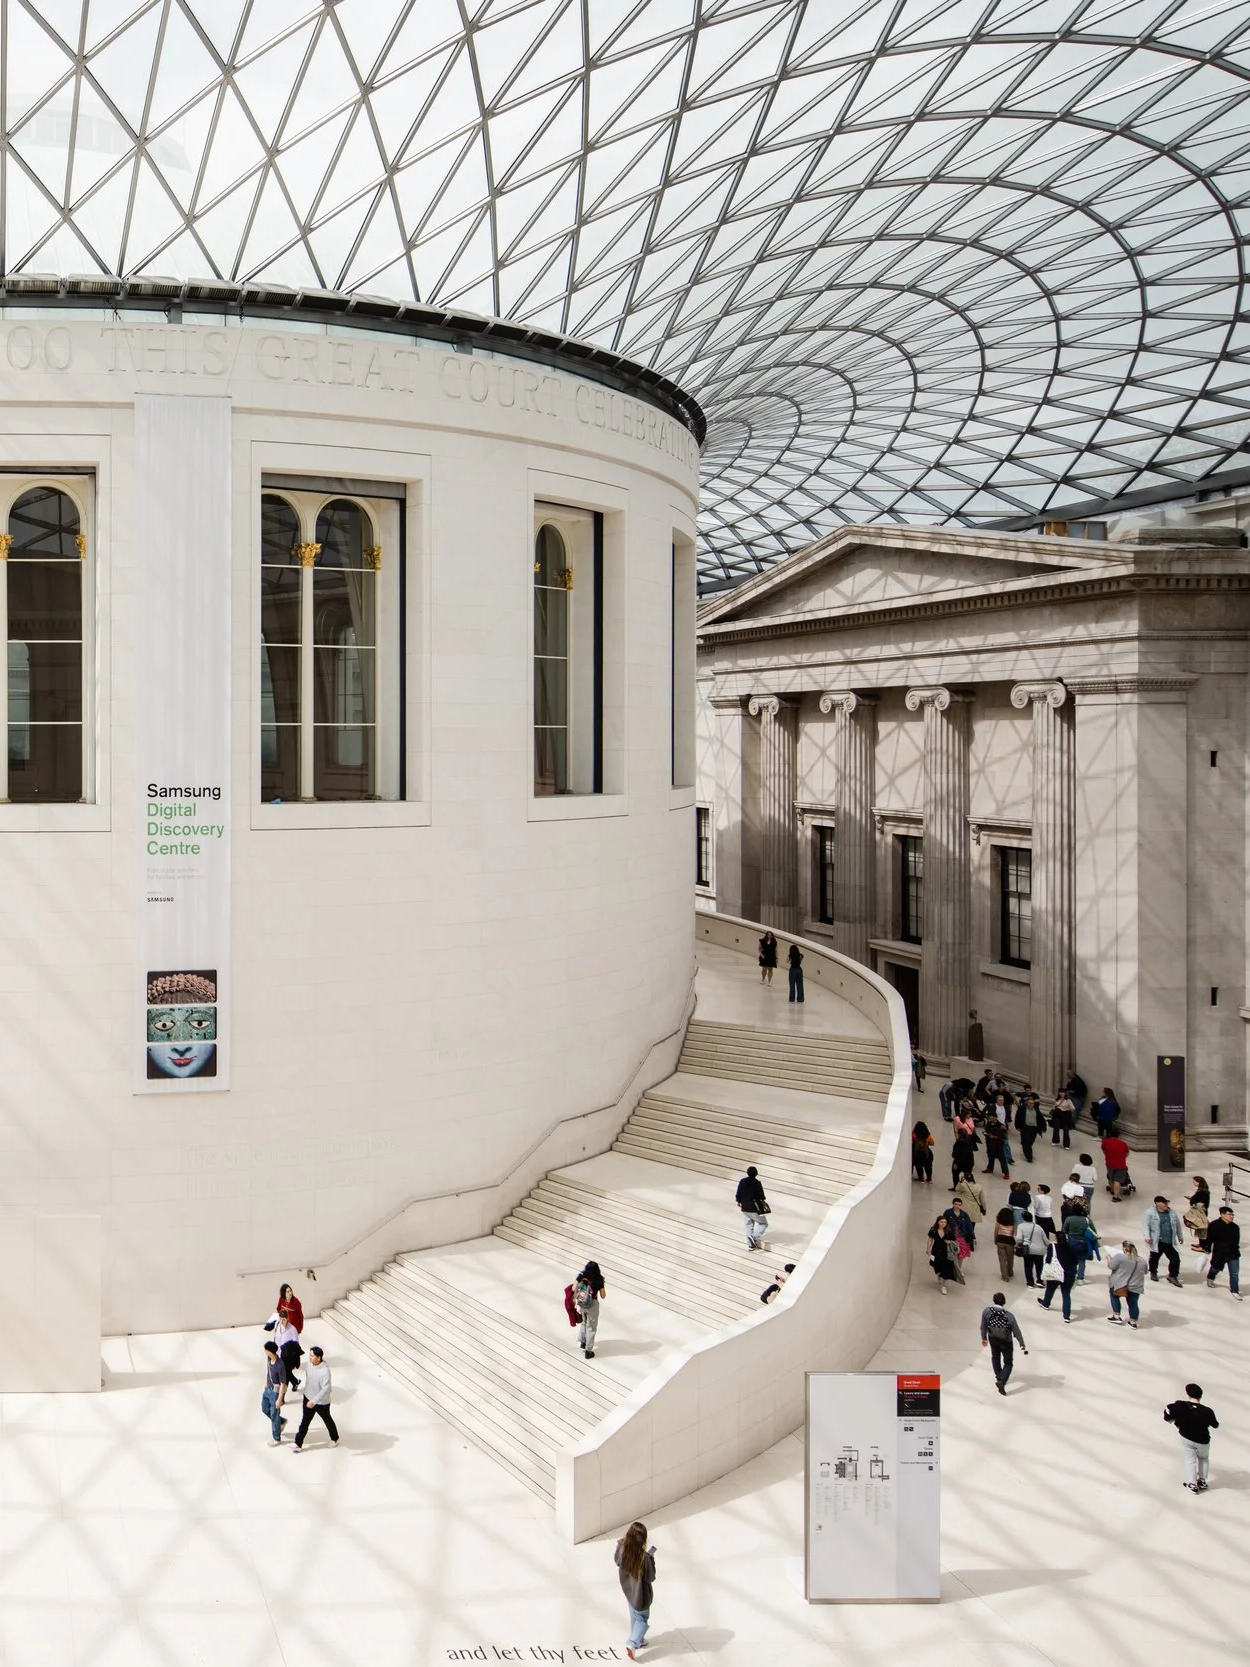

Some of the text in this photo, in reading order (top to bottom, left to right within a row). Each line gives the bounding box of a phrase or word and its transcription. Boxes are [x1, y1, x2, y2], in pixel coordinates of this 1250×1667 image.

[100, 327, 229, 376] THIS
[255, 335, 421, 393] GREAT
[439, 356, 562, 417] COURT
[147, 783, 221, 800] Samsung
[147, 802, 196, 820] Digital
[147, 822, 224, 838] Discovery
[147, 841, 200, 855] Centre
[446, 1645, 622, 1663] and let thy feet
